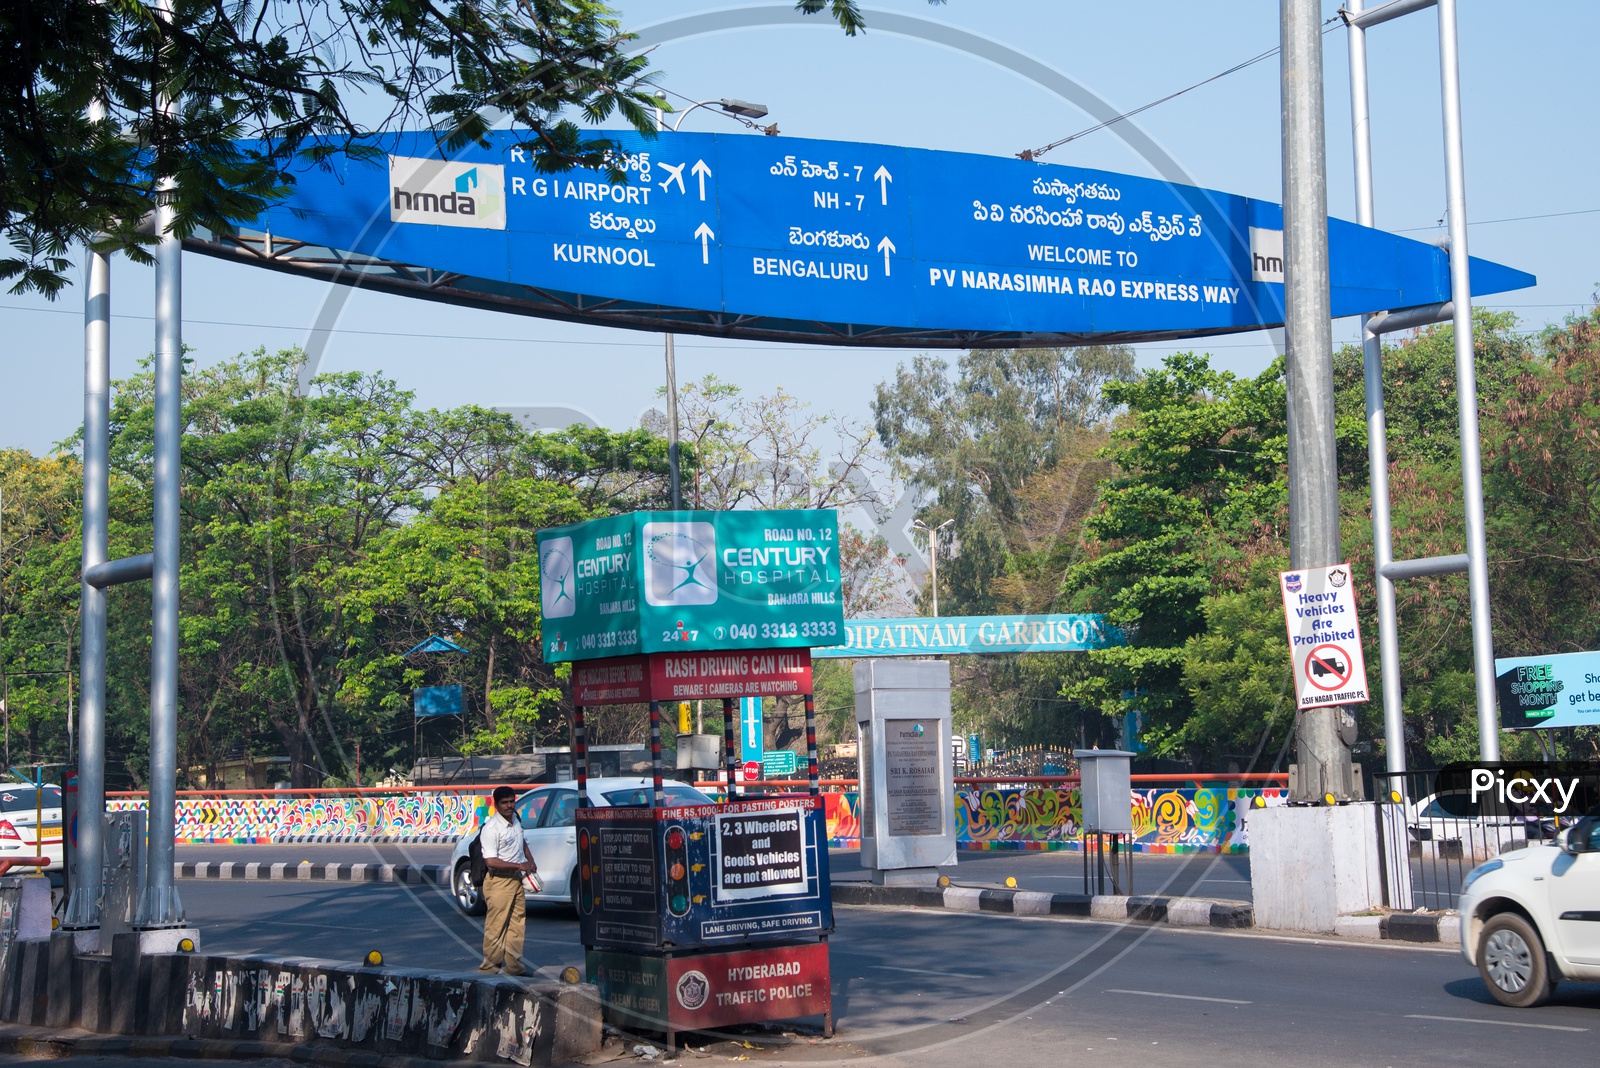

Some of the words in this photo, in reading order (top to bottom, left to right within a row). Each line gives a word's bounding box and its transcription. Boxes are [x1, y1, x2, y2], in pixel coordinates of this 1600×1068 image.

[853, 166, 864, 182] 7
[512, 176, 527, 195] R
[532, 178, 548, 197] G
[554, 180, 559, 198] I
[563, 181, 651, 205] AIRPORT
[1032, 178, 1121, 204] సుస్వాగతము
[393, 186, 476, 216] hmda
[813, 191, 840, 209] NH
[855, 194, 865, 211] 7
[1010, 205, 1084, 229] నరసింహా
[1086, 213, 1125, 236] రావు
[788, 226, 870, 250] బెంగళూరు
[553, 243, 656, 267] KURNOOL
[1027, 244, 1113, 267] WELCOME
[1116, 250, 1139, 269] TO
[1253, 252, 1283, 273] hm
[752, 257, 869, 281] BENGALURU
[929, 267, 957, 288] PV
[961, 270, 1073, 295] NARASIMHA
[1077, 278, 1116, 298] RAO
[1120, 280, 1200, 303] EXPRESS
[1203, 285, 1240, 305] WAY
[596, 536, 611, 551] ROAD
[624, 532, 632, 547] 12
[764, 528, 793, 542] ROAD
[796, 528, 816, 542] NO.
[819, 528, 832, 541] 12
[577, 552, 631, 579] CENTURY
[723, 547, 832, 567] CENTURY
[724, 570, 835, 585] HOSPITAL
[577, 578, 635, 596] HOSPITAL
[622, 599, 636, 612] HILLS
[767, 593, 810, 606] BANJARA
[811, 592, 836, 605] HILLS
[1298, 592, 1338, 605] Heavy
[1295, 604, 1345, 618] Vehicles
[729, 623, 757, 640] 040
[761, 622, 798, 639] 3313
[801, 621, 837, 637] 3333
[1312, 619, 1333, 631] Are
[581, 634, 596, 650] 040
[597, 631, 617, 648] 3313
[617, 629, 638, 646] 3333
[842, 622, 968, 650] DIPATNAM
[978, 619, 1106, 647] GARRISON
[1293, 629, 1355, 646] Prohibited
[665, 656, 697, 678] RASH
[701, 655, 749, 677] DRIVING
[751, 655, 775, 675] CAN
[778, 653, 804, 674] KILL
[1516, 664, 1554, 681] FREE
[673, 684, 704, 696] BEWARE
[709, 683, 743, 695] CAMERAS
[745, 682, 759, 693] ARE
[760, 680, 798, 693] WATCHING
[1511, 680, 1564, 695] SHOPPING
[1302, 696, 1314, 706] ASIF
[1314, 694, 1333, 704] NAGAR
[1334, 691, 1357, 702] TRAFFIC
[1519, 693, 1558, 706] MONTH
[1569, 692, 1586, 706] get
[909, 767, 935, 775] ROSAIAH
[606, 810, 615, 819] FOR
[634, 810, 653, 819] POSTERS
[662, 808, 681, 819] FINE
[723, 804, 739, 814] FOR
[742, 800, 778, 812] PASTING
[779, 798, 815, 810] POSTERS
[734, 822, 743, 835] 3
[744, 819, 798, 834] Wheelers
[623, 834, 633, 843] NOT
[633, 834, 649, 844] CROSS
[751, 836, 771, 850] and
[604, 845, 618, 854] STOP
[618, 845, 632, 854] LINE
[604, 863, 613, 872] GET
[614, 861, 630, 872] READY
[631, 864, 638, 873] TO
[639, 864, 651, 874] STOP
[724, 853, 755, 868] Goods
[757, 851, 800, 866] Vehicles
[604, 875, 617, 884] HALT
[618, 875, 625, 884] AT
[626, 875, 640, 885] STOP
[640, 876, 652, 886] LINE
[724, 873, 741, 884] are
[743, 870, 760, 882] not
[761, 867, 800, 882] allowed
[705, 924, 725, 934] LANE
[726, 921, 760, 933] DRIVING,
[761, 918, 780, 930] SAFE
[782, 917, 813, 927] DRIVING
[608, 968, 626, 983] KEEP
[627, 971, 641, 985] THE
[642, 973, 658, 987] CITY
[728, 961, 801, 982] HYDERABAD
[610, 992, 631, 1008] CLEAN
[638, 997, 660, 1013] GREEN
[716, 988, 766, 1007] TRAFFIC
[769, 984, 813, 1001] POLICE
